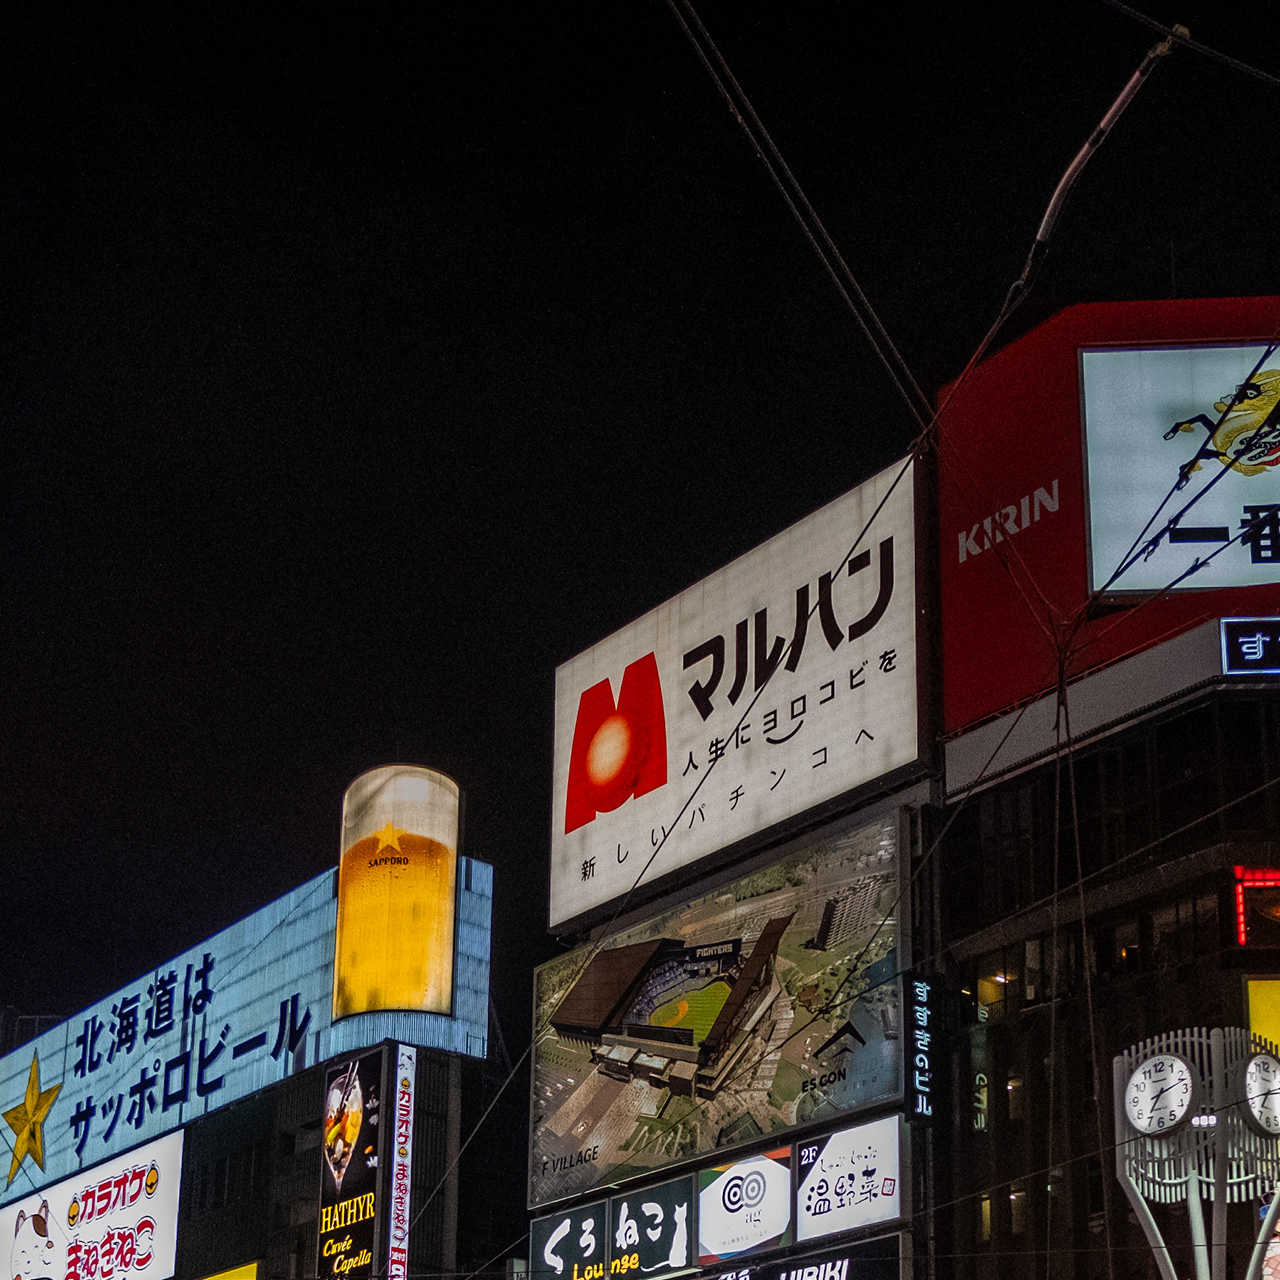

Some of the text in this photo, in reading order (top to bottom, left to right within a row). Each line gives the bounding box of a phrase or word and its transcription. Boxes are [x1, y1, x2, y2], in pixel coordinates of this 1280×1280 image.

[957, 479, 1060, 563] KIRIN
[682, 535, 894, 722] マルハン
[682, 648, 897, 777] 人生にヨロコビを
[580, 728, 875, 882] 新しいパチンコへ
[367, 856, 409, 868] SAPPORO
[696, 943, 733, 958] FIGHTERS
[73, 953, 217, 1079] 北海道は
[70, 993, 313, 1156] サッポロビール
[399, 1089, 412, 1146] カラオケ
[551, 1145, 599, 1174] VILLAGE
[801, 1146, 818, 1165] 2F
[80, 1169, 146, 1222] カラオケ
[321, 1192, 375, 1233] HATHYR
[806, 1165, 880, 1216] 温野菜
[323, 1235, 353, 1257] Cuvée
[333, 1249, 372, 1274] Capella
[544, 1202, 663, 1274] くろねこ
